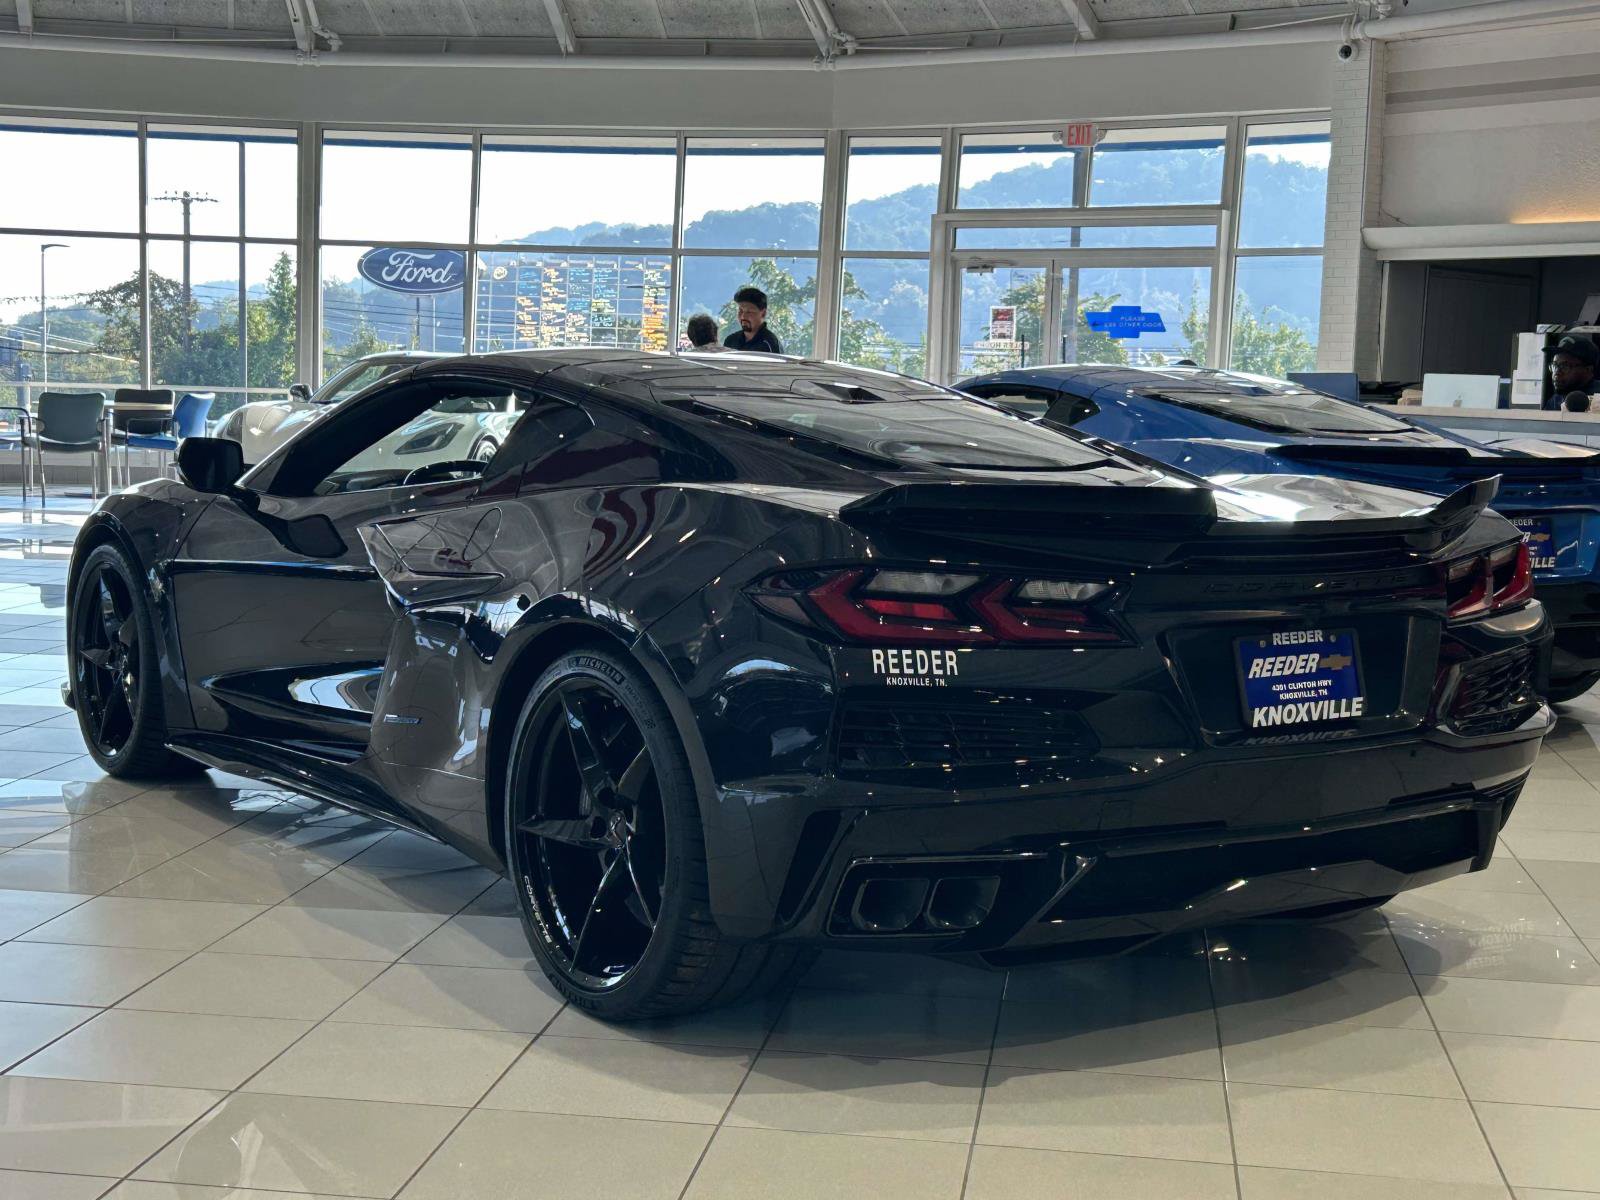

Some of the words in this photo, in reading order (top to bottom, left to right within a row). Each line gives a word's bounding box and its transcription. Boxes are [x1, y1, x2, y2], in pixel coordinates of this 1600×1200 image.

[1068, 124, 1092, 145] EXIT
[382, 251, 454, 283] Ford
[1272, 629, 1323, 646] REEDER
[578, 657, 622, 684] MICHELIN
[872, 649, 958, 675] REEDER
[1248, 653, 1320, 679] REEDER
[886, 677, 933, 688] KNOXVILLE,
[1288, 681, 1317, 690] CLINTON
[1317, 679, 1332, 687] HWY
[1252, 696, 1364, 728] KNOXVILLE
